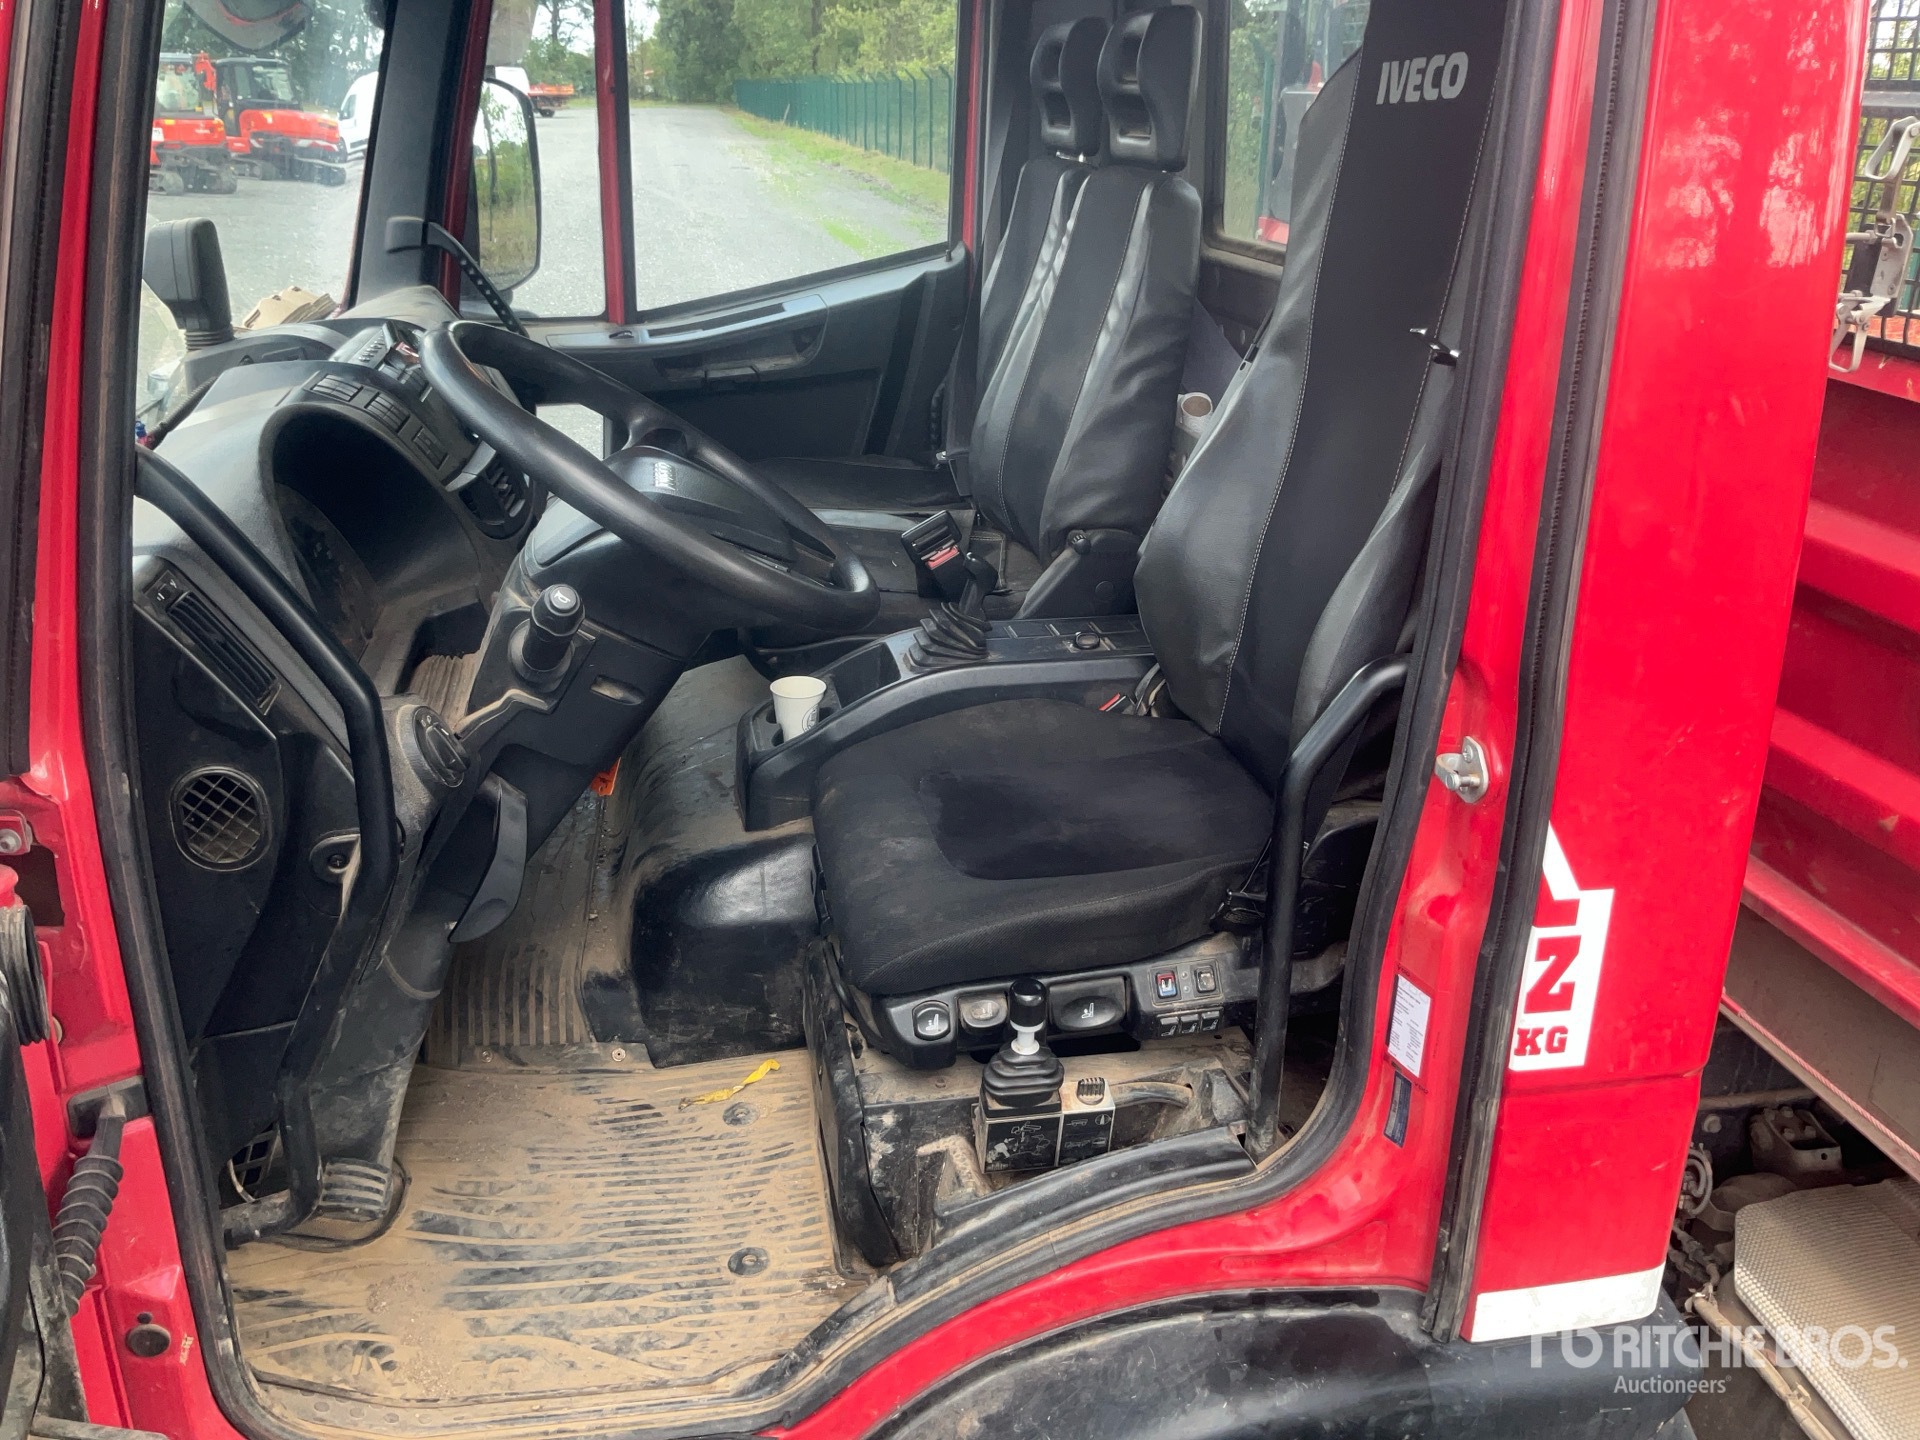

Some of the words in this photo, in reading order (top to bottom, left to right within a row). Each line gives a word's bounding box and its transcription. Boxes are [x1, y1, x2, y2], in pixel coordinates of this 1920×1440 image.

[1376, 51, 1469, 105] IVECO
[1524, 934, 1582, 1014] Z
[1514, 1025, 1569, 1057] KG
